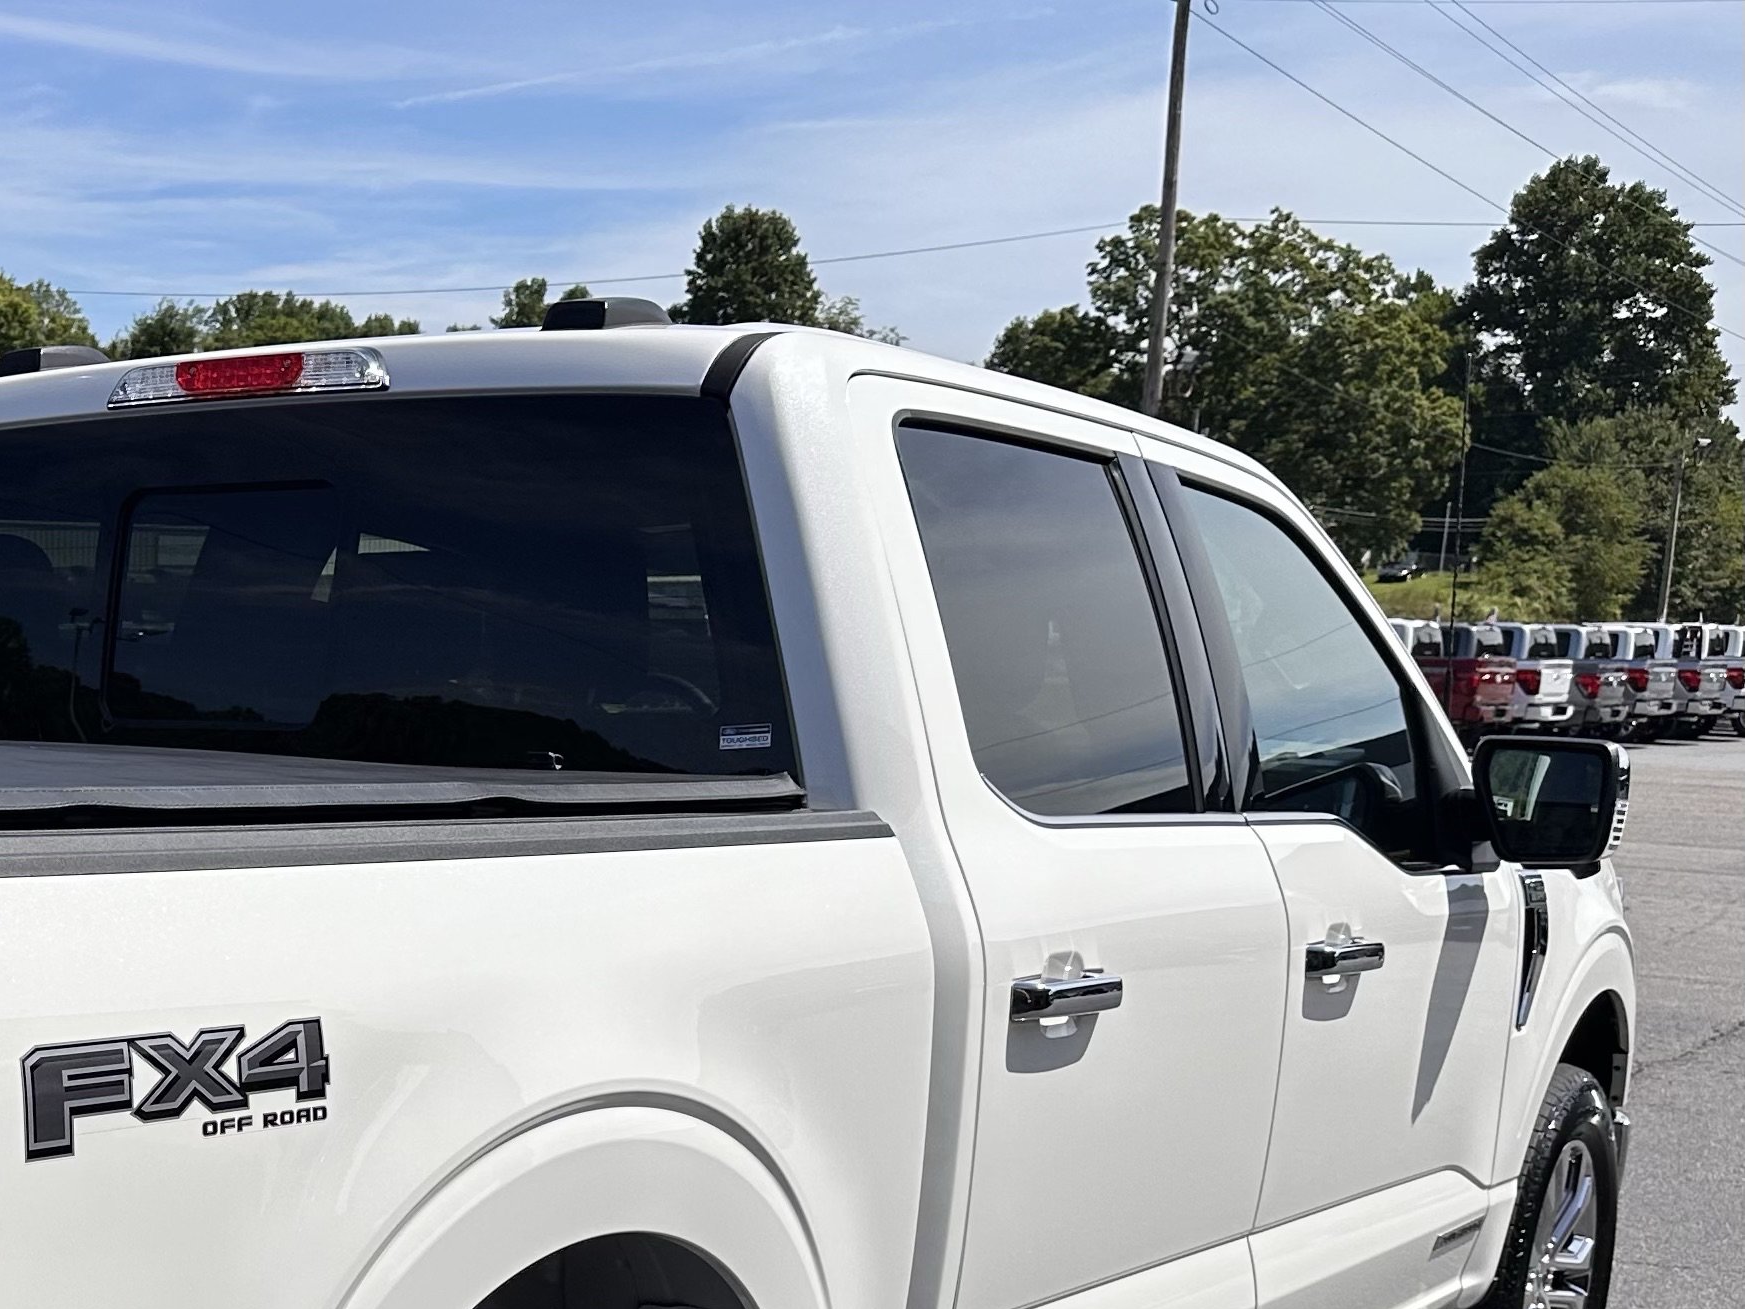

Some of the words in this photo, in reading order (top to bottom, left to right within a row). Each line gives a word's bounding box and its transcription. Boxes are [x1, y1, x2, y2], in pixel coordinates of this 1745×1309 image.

[20, 1016, 330, 1163] FX4
[202, 1115, 253, 1138] OFF
[262, 1106, 328, 1130] ROAD
